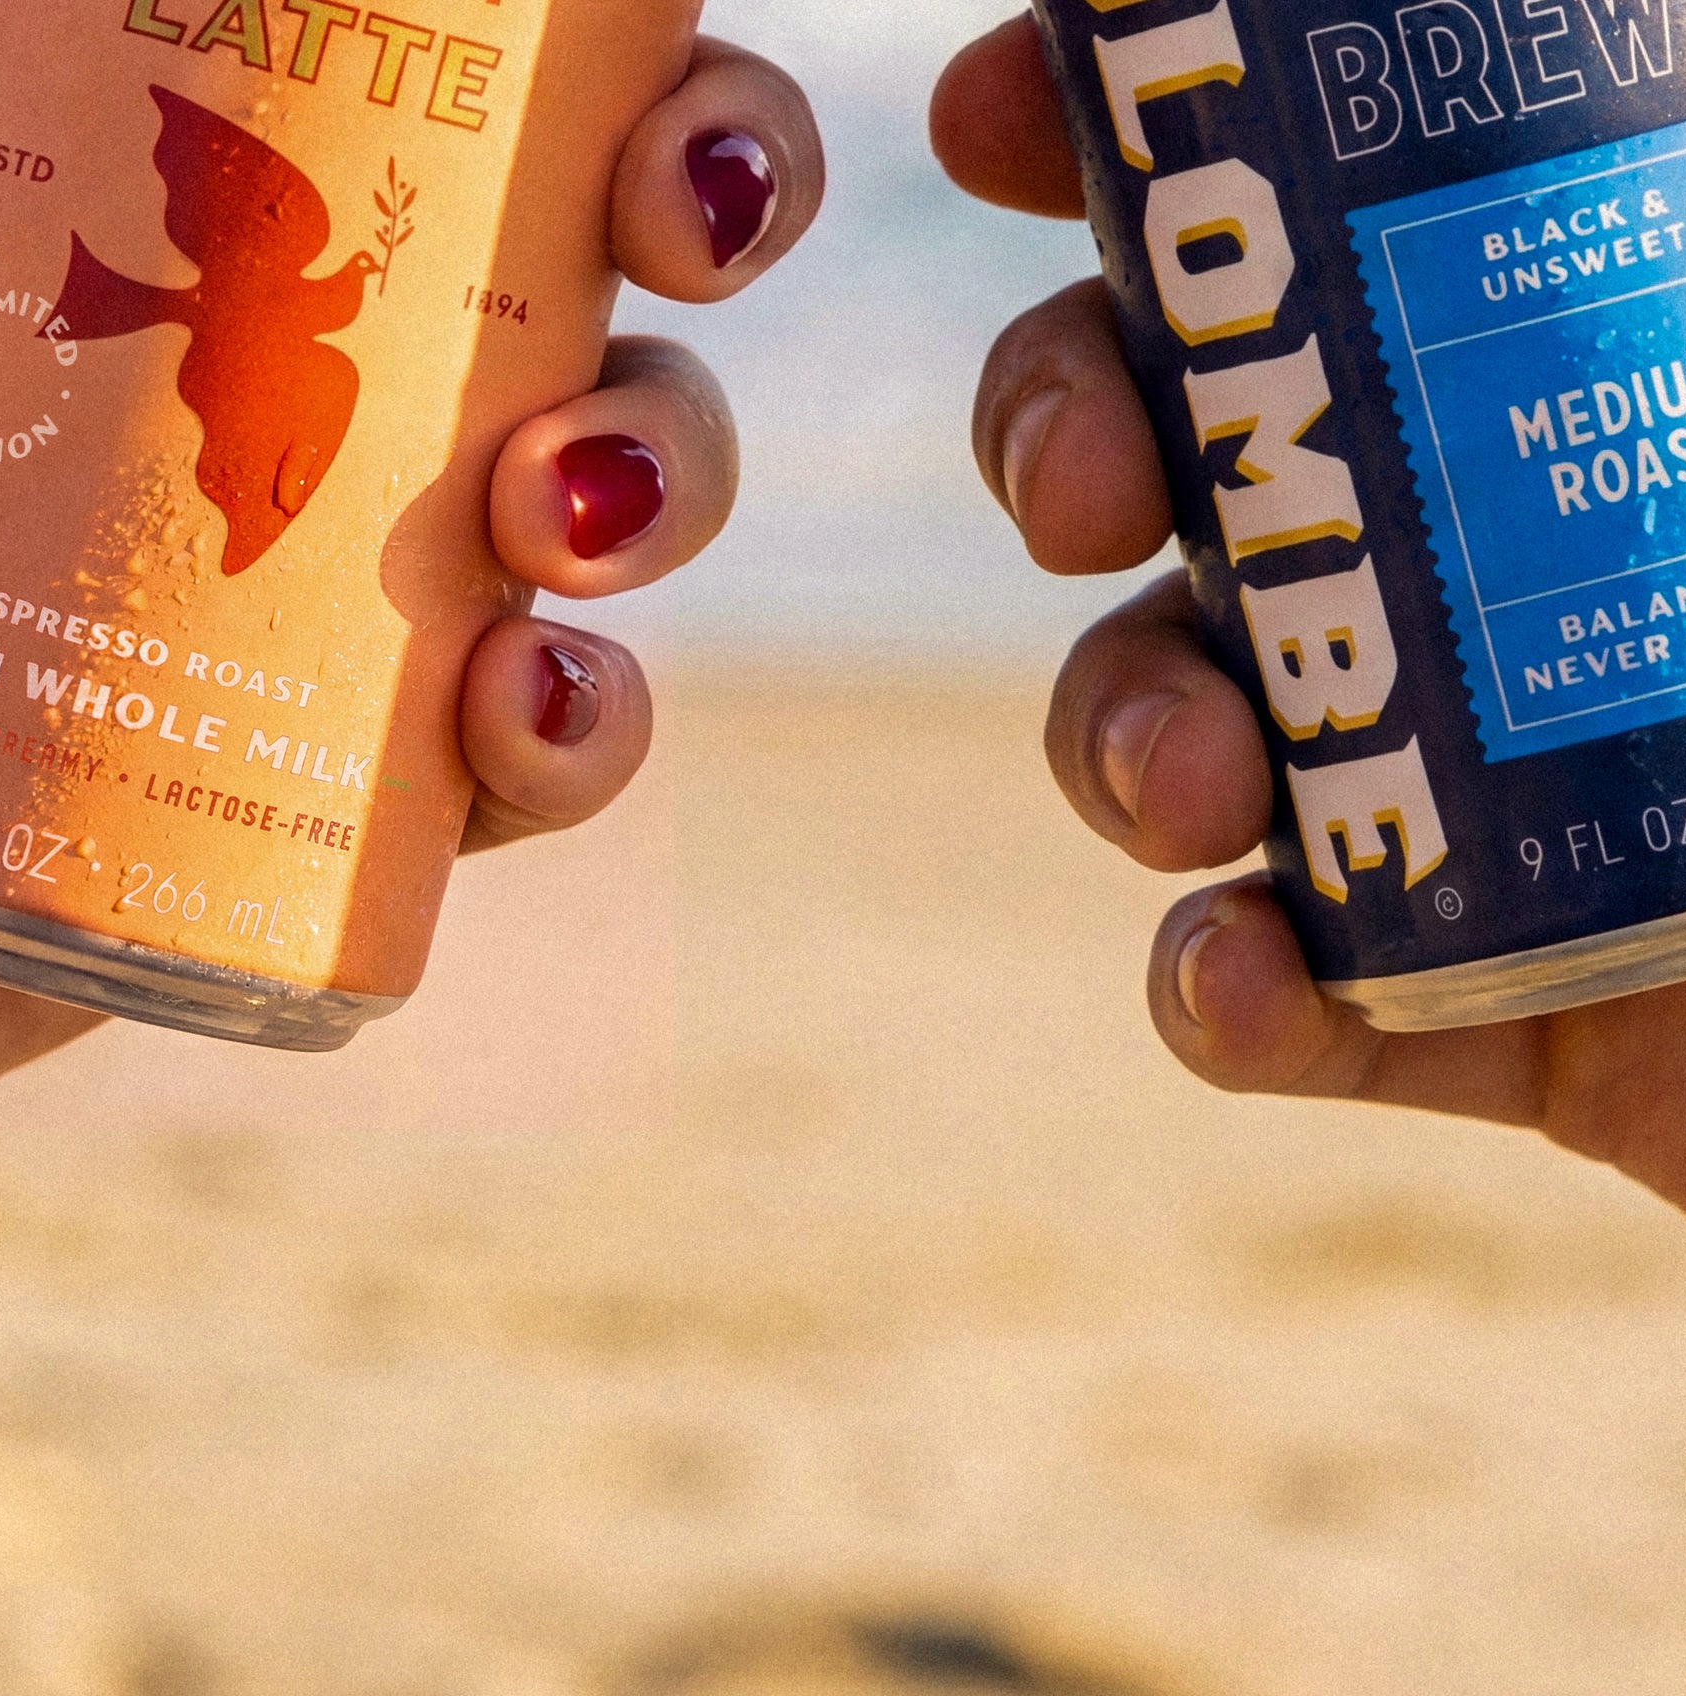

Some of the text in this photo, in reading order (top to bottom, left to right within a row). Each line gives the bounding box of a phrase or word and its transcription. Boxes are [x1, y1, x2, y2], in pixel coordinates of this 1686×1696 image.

[1482, 188, 1670, 261] BLACK &
[184, 651, 319, 709] ROAST
[1524, 632, 1670, 695] NEVER
[26, 662, 228, 754] WHOLE
[243, 727, 374, 792] MILK
[143, 773, 356, 852] LACTOSE-FREE
[1, 823, 70, 885] OZ
[121, 861, 208, 923] 266
[226, 895, 285, 947] mL
[1518, 837, 1545, 883] 9
[1565, 821, 1624, 873] FL
